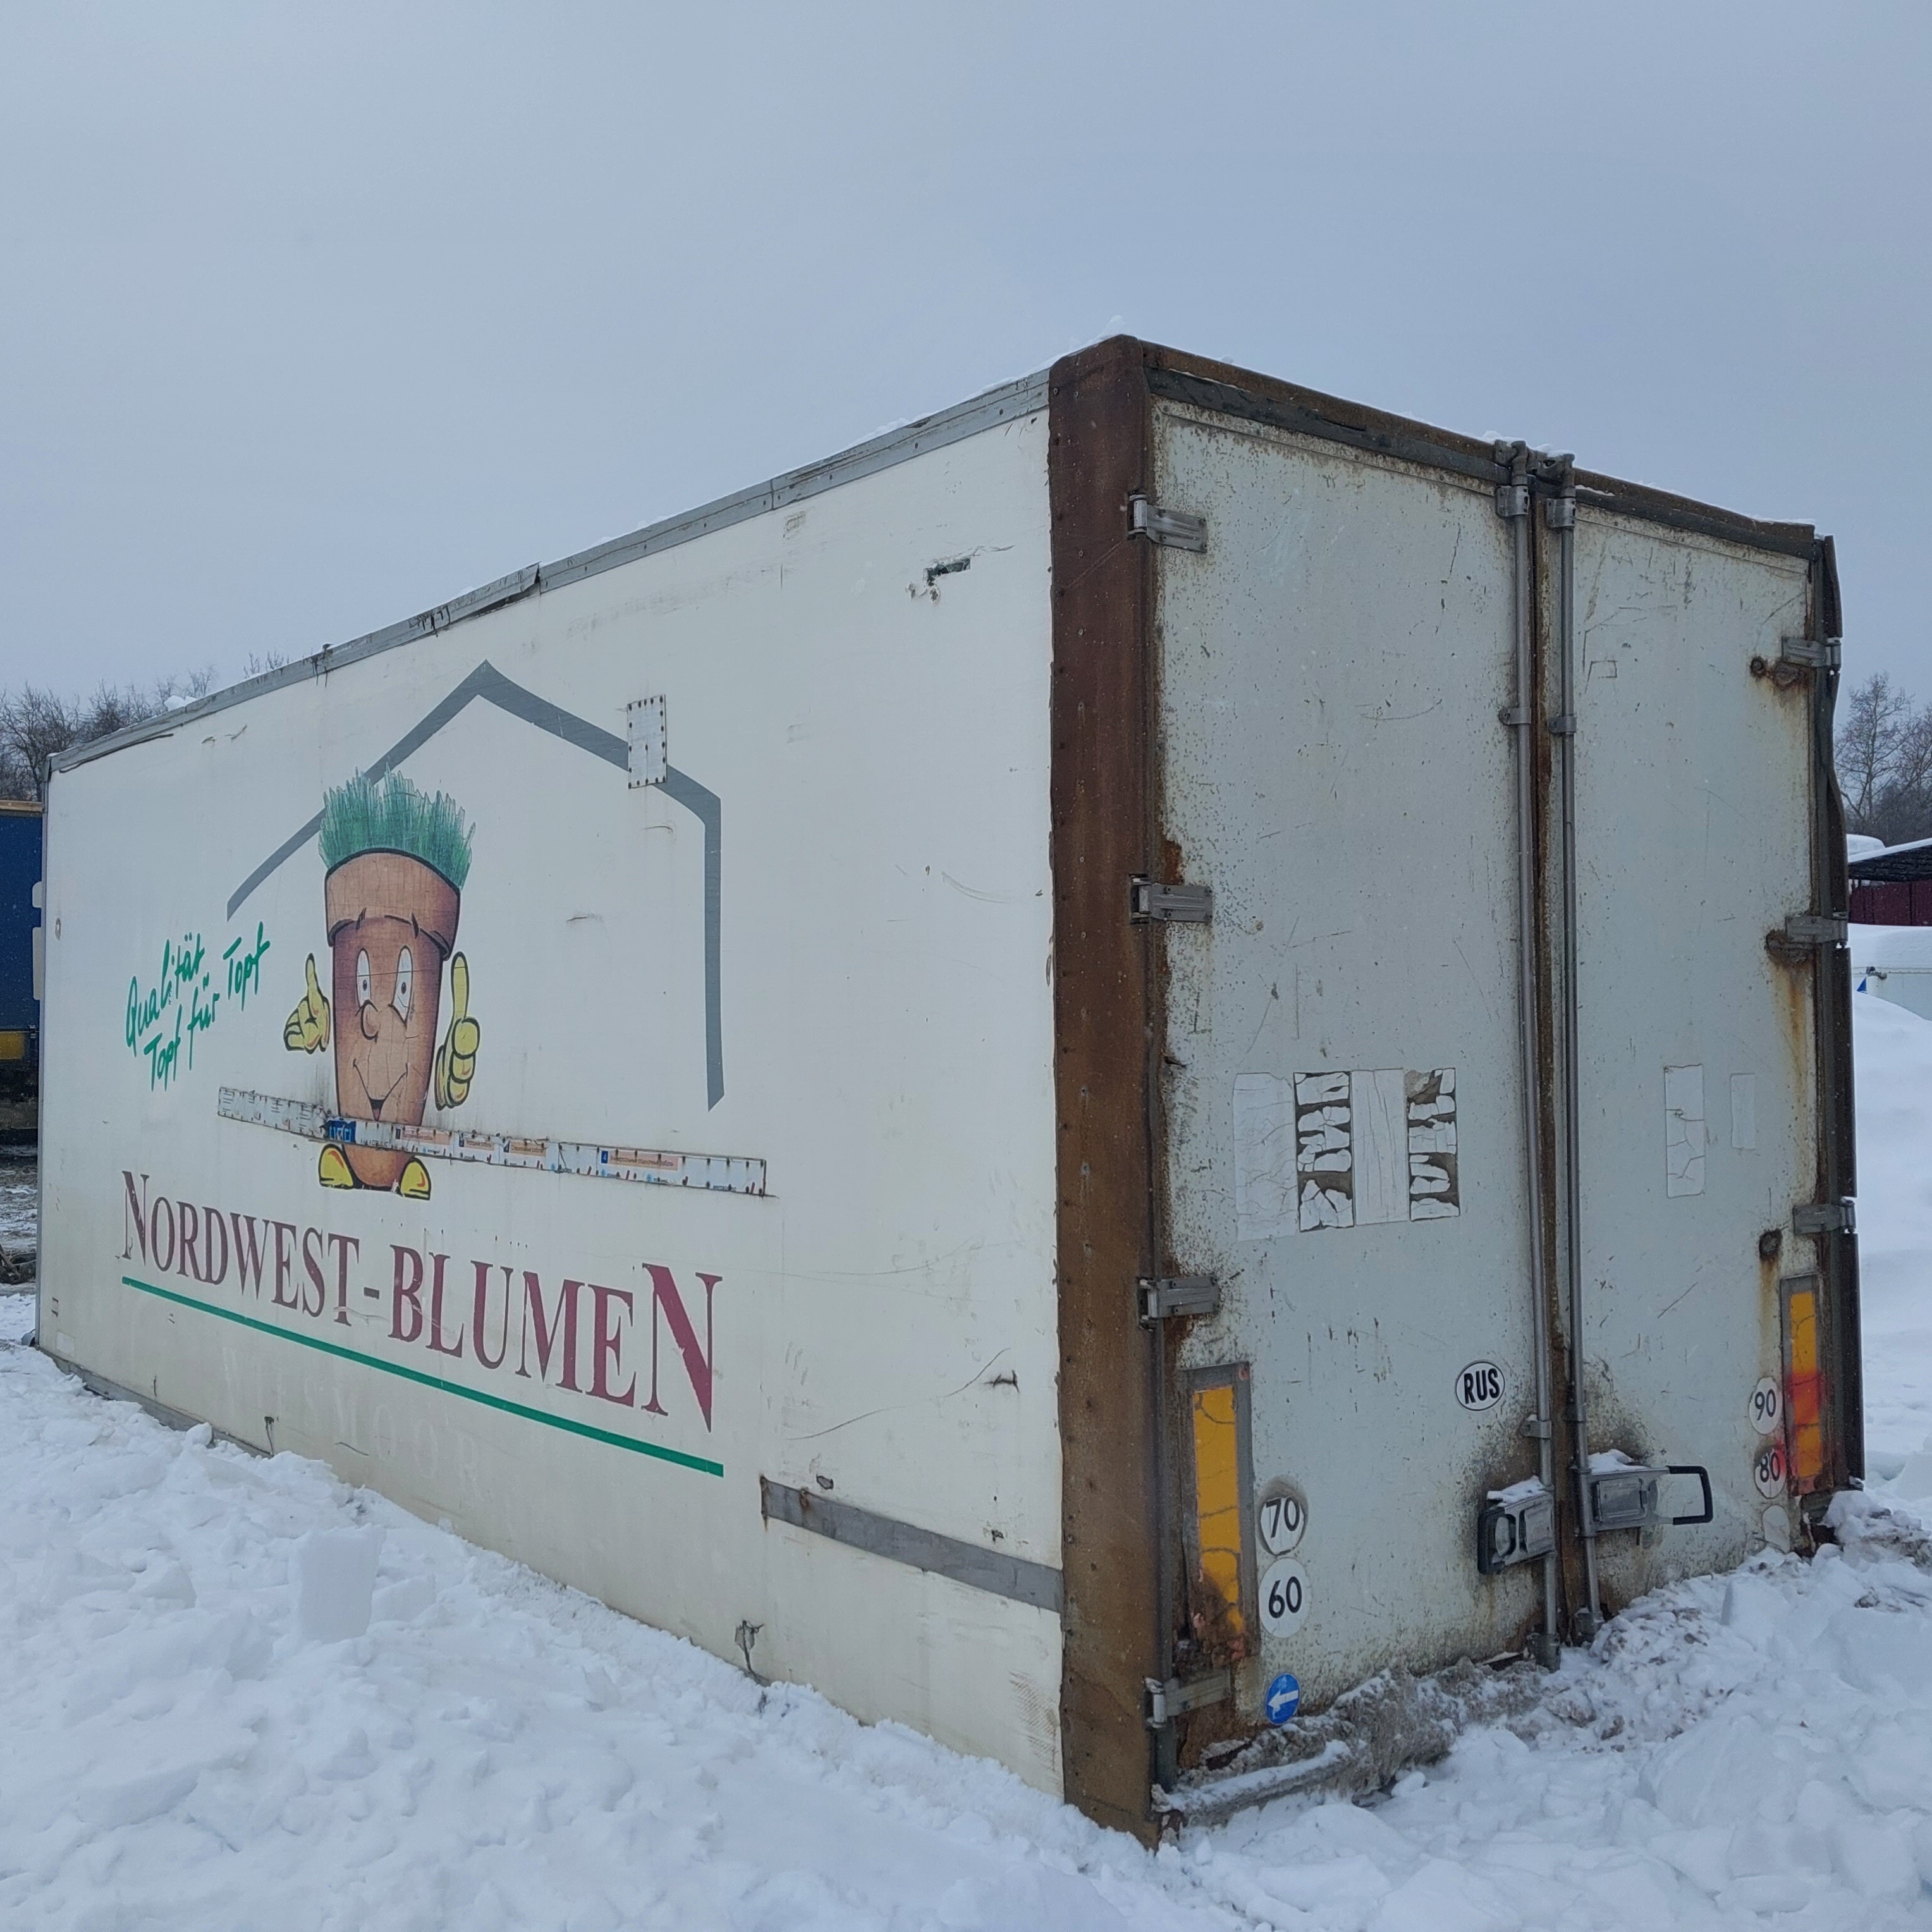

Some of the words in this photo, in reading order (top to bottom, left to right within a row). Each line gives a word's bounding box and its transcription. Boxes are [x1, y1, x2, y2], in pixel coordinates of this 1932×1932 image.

[126, 932, 205, 1058] Qualität
[144, 1004, 183, 1092] Topf
[187, 972, 220, 1071] für
[223, 920, 271, 1012] Topf
[121, 1170, 723, 1433] NORDWEST-BLUMEN
[1464, 1367, 1500, 1405] RUS
[1754, 1388, 1776, 1421] 90
[1759, 1452, 1781, 1483] 80
[1266, 1497, 1300, 1539] 70
[1268, 1576, 1302, 1619] 60
